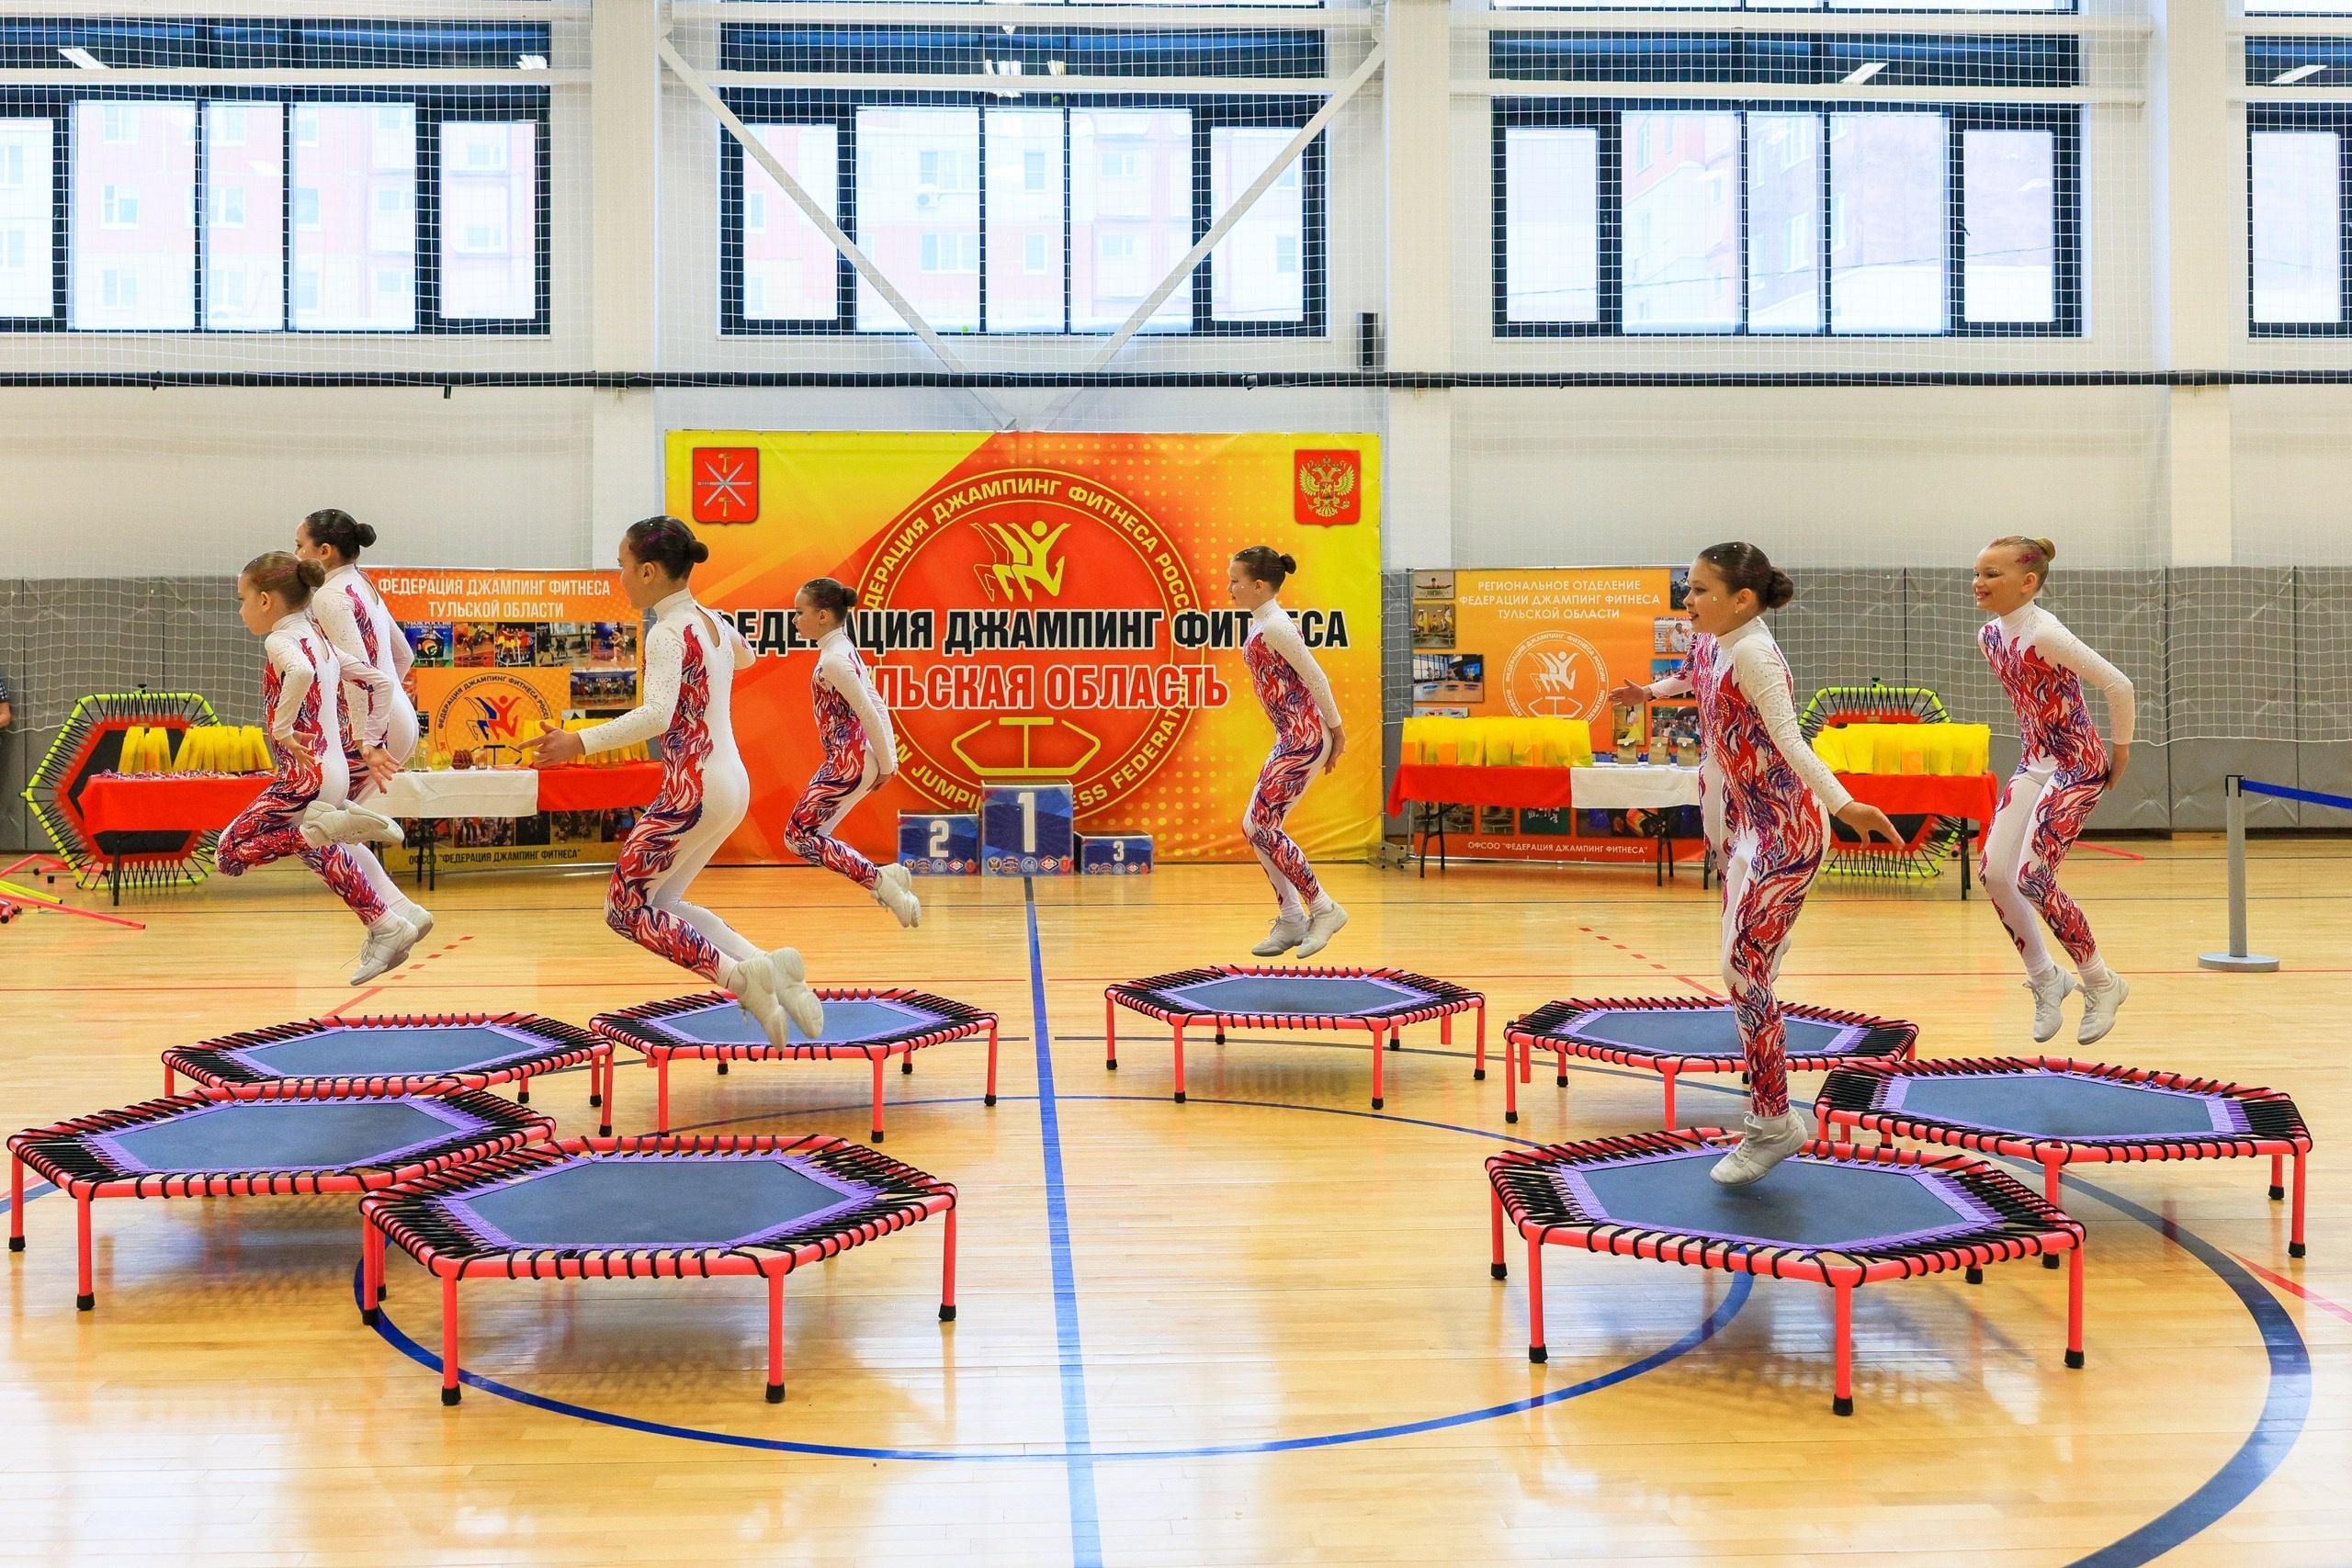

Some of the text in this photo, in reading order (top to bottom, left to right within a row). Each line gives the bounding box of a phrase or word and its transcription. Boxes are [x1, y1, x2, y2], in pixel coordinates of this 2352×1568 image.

[862, 478, 1193, 614] ДЕРАЦИЯ ДЖАМПИНГ ФИТНЕСА РОСС
[378, 578, 611, 596] ФЕДЕРАЦИЯ ДЖАМПИНГ ФИТНЕСА
[1477, 581, 1641, 592] РЕГИОНАЛЬНОЕ ОТДЕЛЕНИЕ
[428, 599, 564, 618] ТУЛЬСКОЙ ОБЛАСТИ
[1459, 594, 1660, 606] ФЕДЕРАЦИИ ДЖАМПИНГ ФИТНЕСА
[1498, 607, 1620, 619] ТУЛЬСКОЙ ОБЛАСТИ
[723, 609, 1351, 657] ЕДЕЦИЯ ДЖАМПИНГ ФИТСА
[1567, 635, 1595, 657] ФИТНЕСА
[868, 664, 1230, 710] ЛЬСКАЯ ОБЛАСТЬ
[438, 675, 549, 729] ФЕДЕРАЦИЯ ДЖАМПИНГ ФИТНЕСА РОСС
[1582, 690, 1606, 720] DERATION
[1110, 703, 1185, 790] FEDERAT
[910, 764, 980, 812] JUMPI
[1018, 792, 1036, 853] 1
[929, 820, 949, 858] 2
[1113, 840, 1125, 862] 3
[1467, 841, 1648, 854] ОФСОО "ФЕДЕРАЦИЯ ДЖАМПИНГ ФИТНЕСА"
[439, 852, 492, 864] "ФЕДЕРАЦИЯ
[492, 851, 539, 863] ДЖАМПИНГ
[541, 849, 582, 860] ФИТНЕСА"
